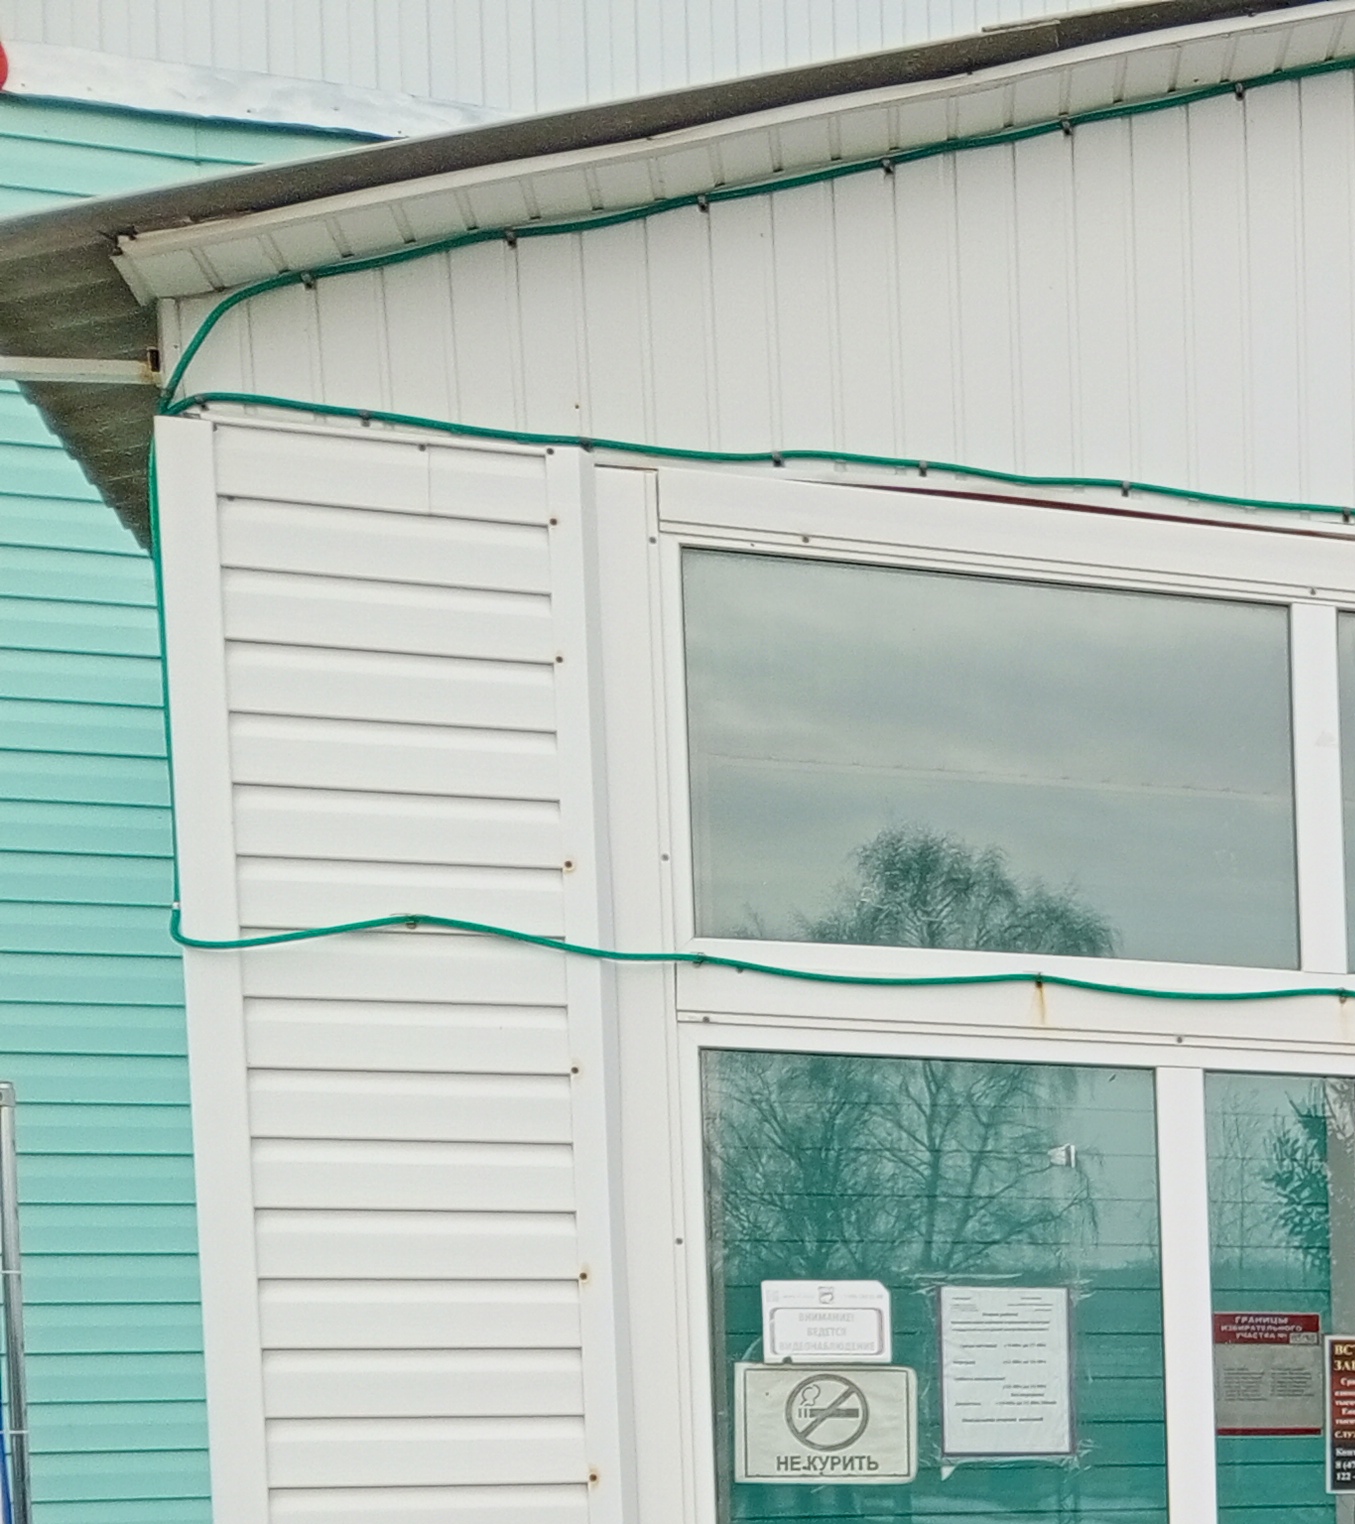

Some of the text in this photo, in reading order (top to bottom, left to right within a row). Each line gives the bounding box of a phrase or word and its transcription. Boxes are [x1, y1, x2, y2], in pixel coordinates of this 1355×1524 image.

[1235, 1316, 1288, 1325] ГРАНИЦЫ
[776, 1455, 879, 1471] НЕ КУРИТЬ
